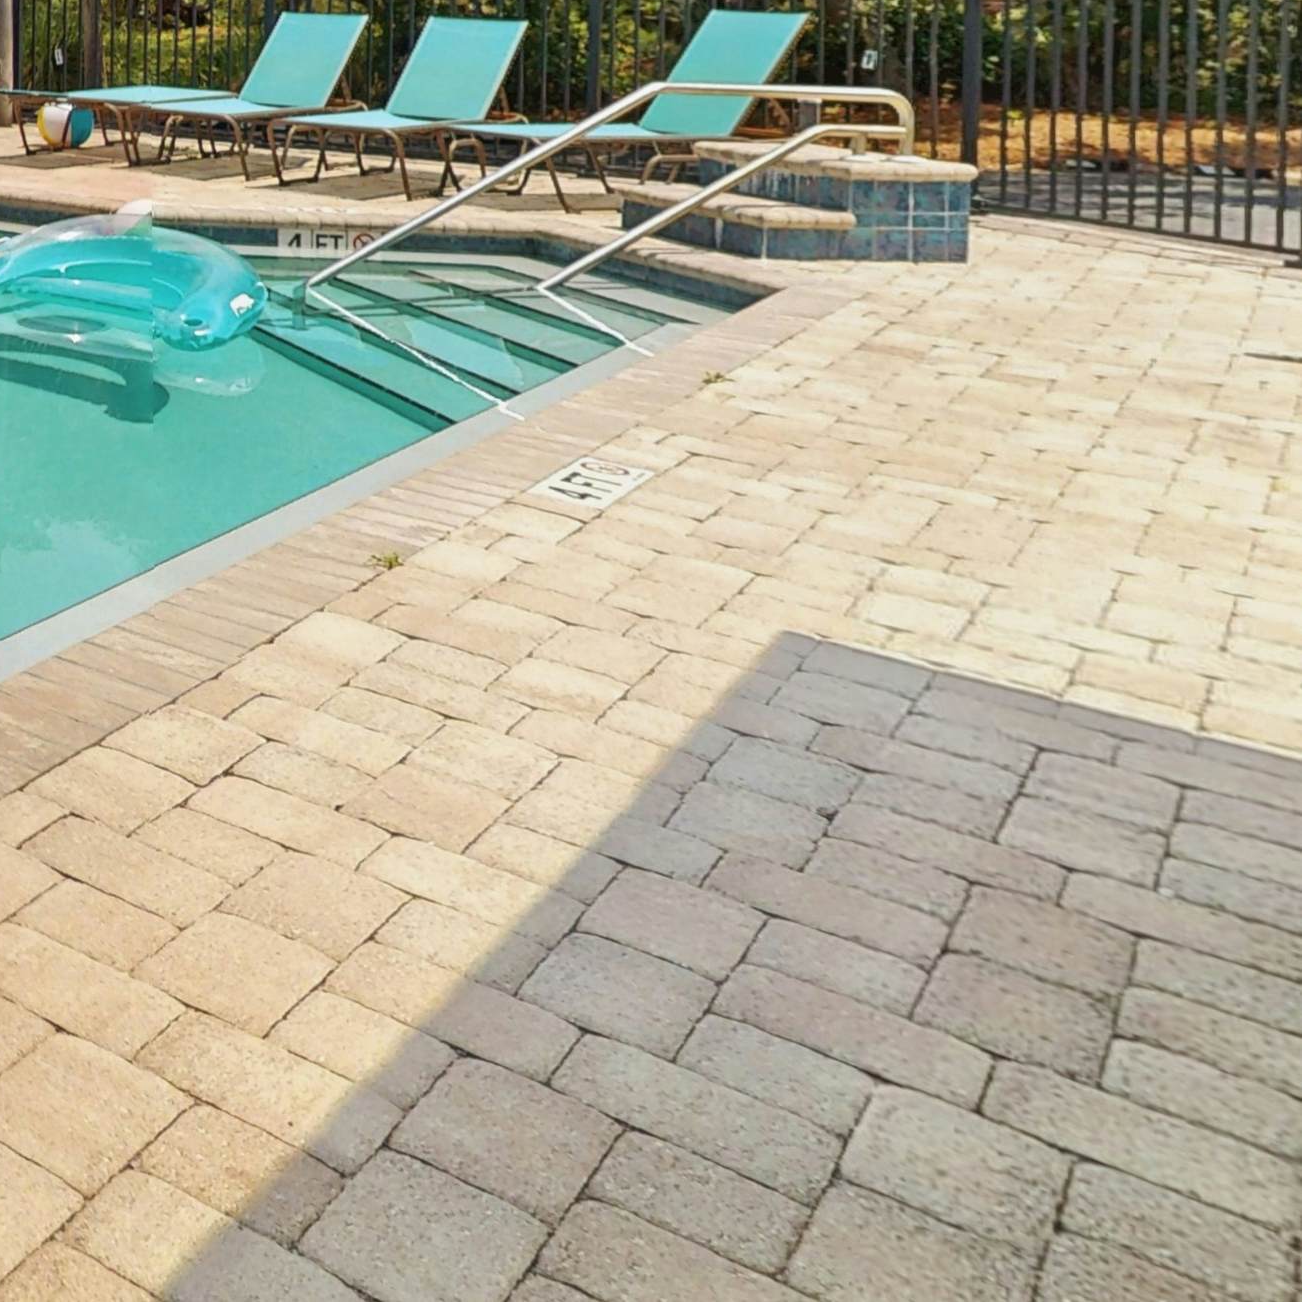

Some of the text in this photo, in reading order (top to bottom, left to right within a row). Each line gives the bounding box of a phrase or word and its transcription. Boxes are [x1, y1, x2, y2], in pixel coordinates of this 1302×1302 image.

[315, 234, 344, 250] FT
[560, 472, 622, 493] FT
[548, 486, 603, 500] 4
